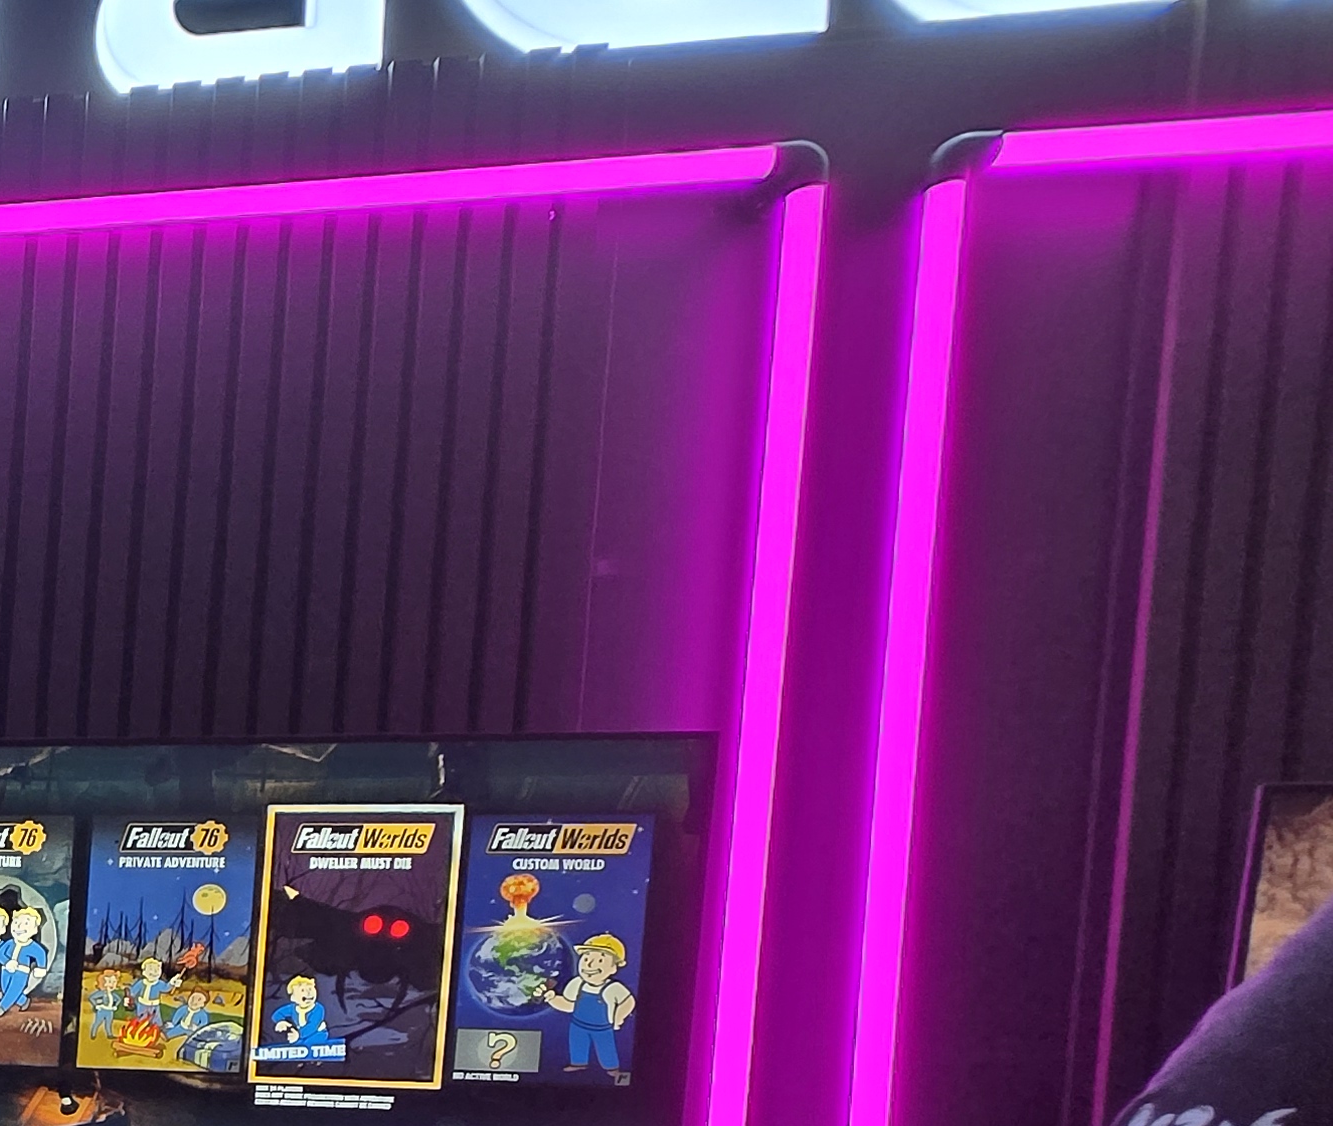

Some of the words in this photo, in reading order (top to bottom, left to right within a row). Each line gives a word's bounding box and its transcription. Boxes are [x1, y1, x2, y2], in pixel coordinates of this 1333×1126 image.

[17, 827, 37, 848] 76
[127, 826, 189, 850] Fallout
[198, 827, 220, 848] 76
[296, 826, 359, 850] Fallout
[363, 827, 429, 850] Worlds
[491, 826, 557, 850] Fallout
[560, 827, 630, 850] Worlds
[119, 856, 162, 869] PRIVATE
[163, 856, 226, 869] ADVENTURE
[309, 856, 359, 870] DWELLER
[360, 857, 392, 870] MUST
[393, 857, 413, 870] DIE
[512, 858, 560, 872] CUSTOM
[561, 858, 606, 872] WORLD
[251, 1046, 309, 1061] LIMITED
[311, 1044, 347, 1059] TIME
